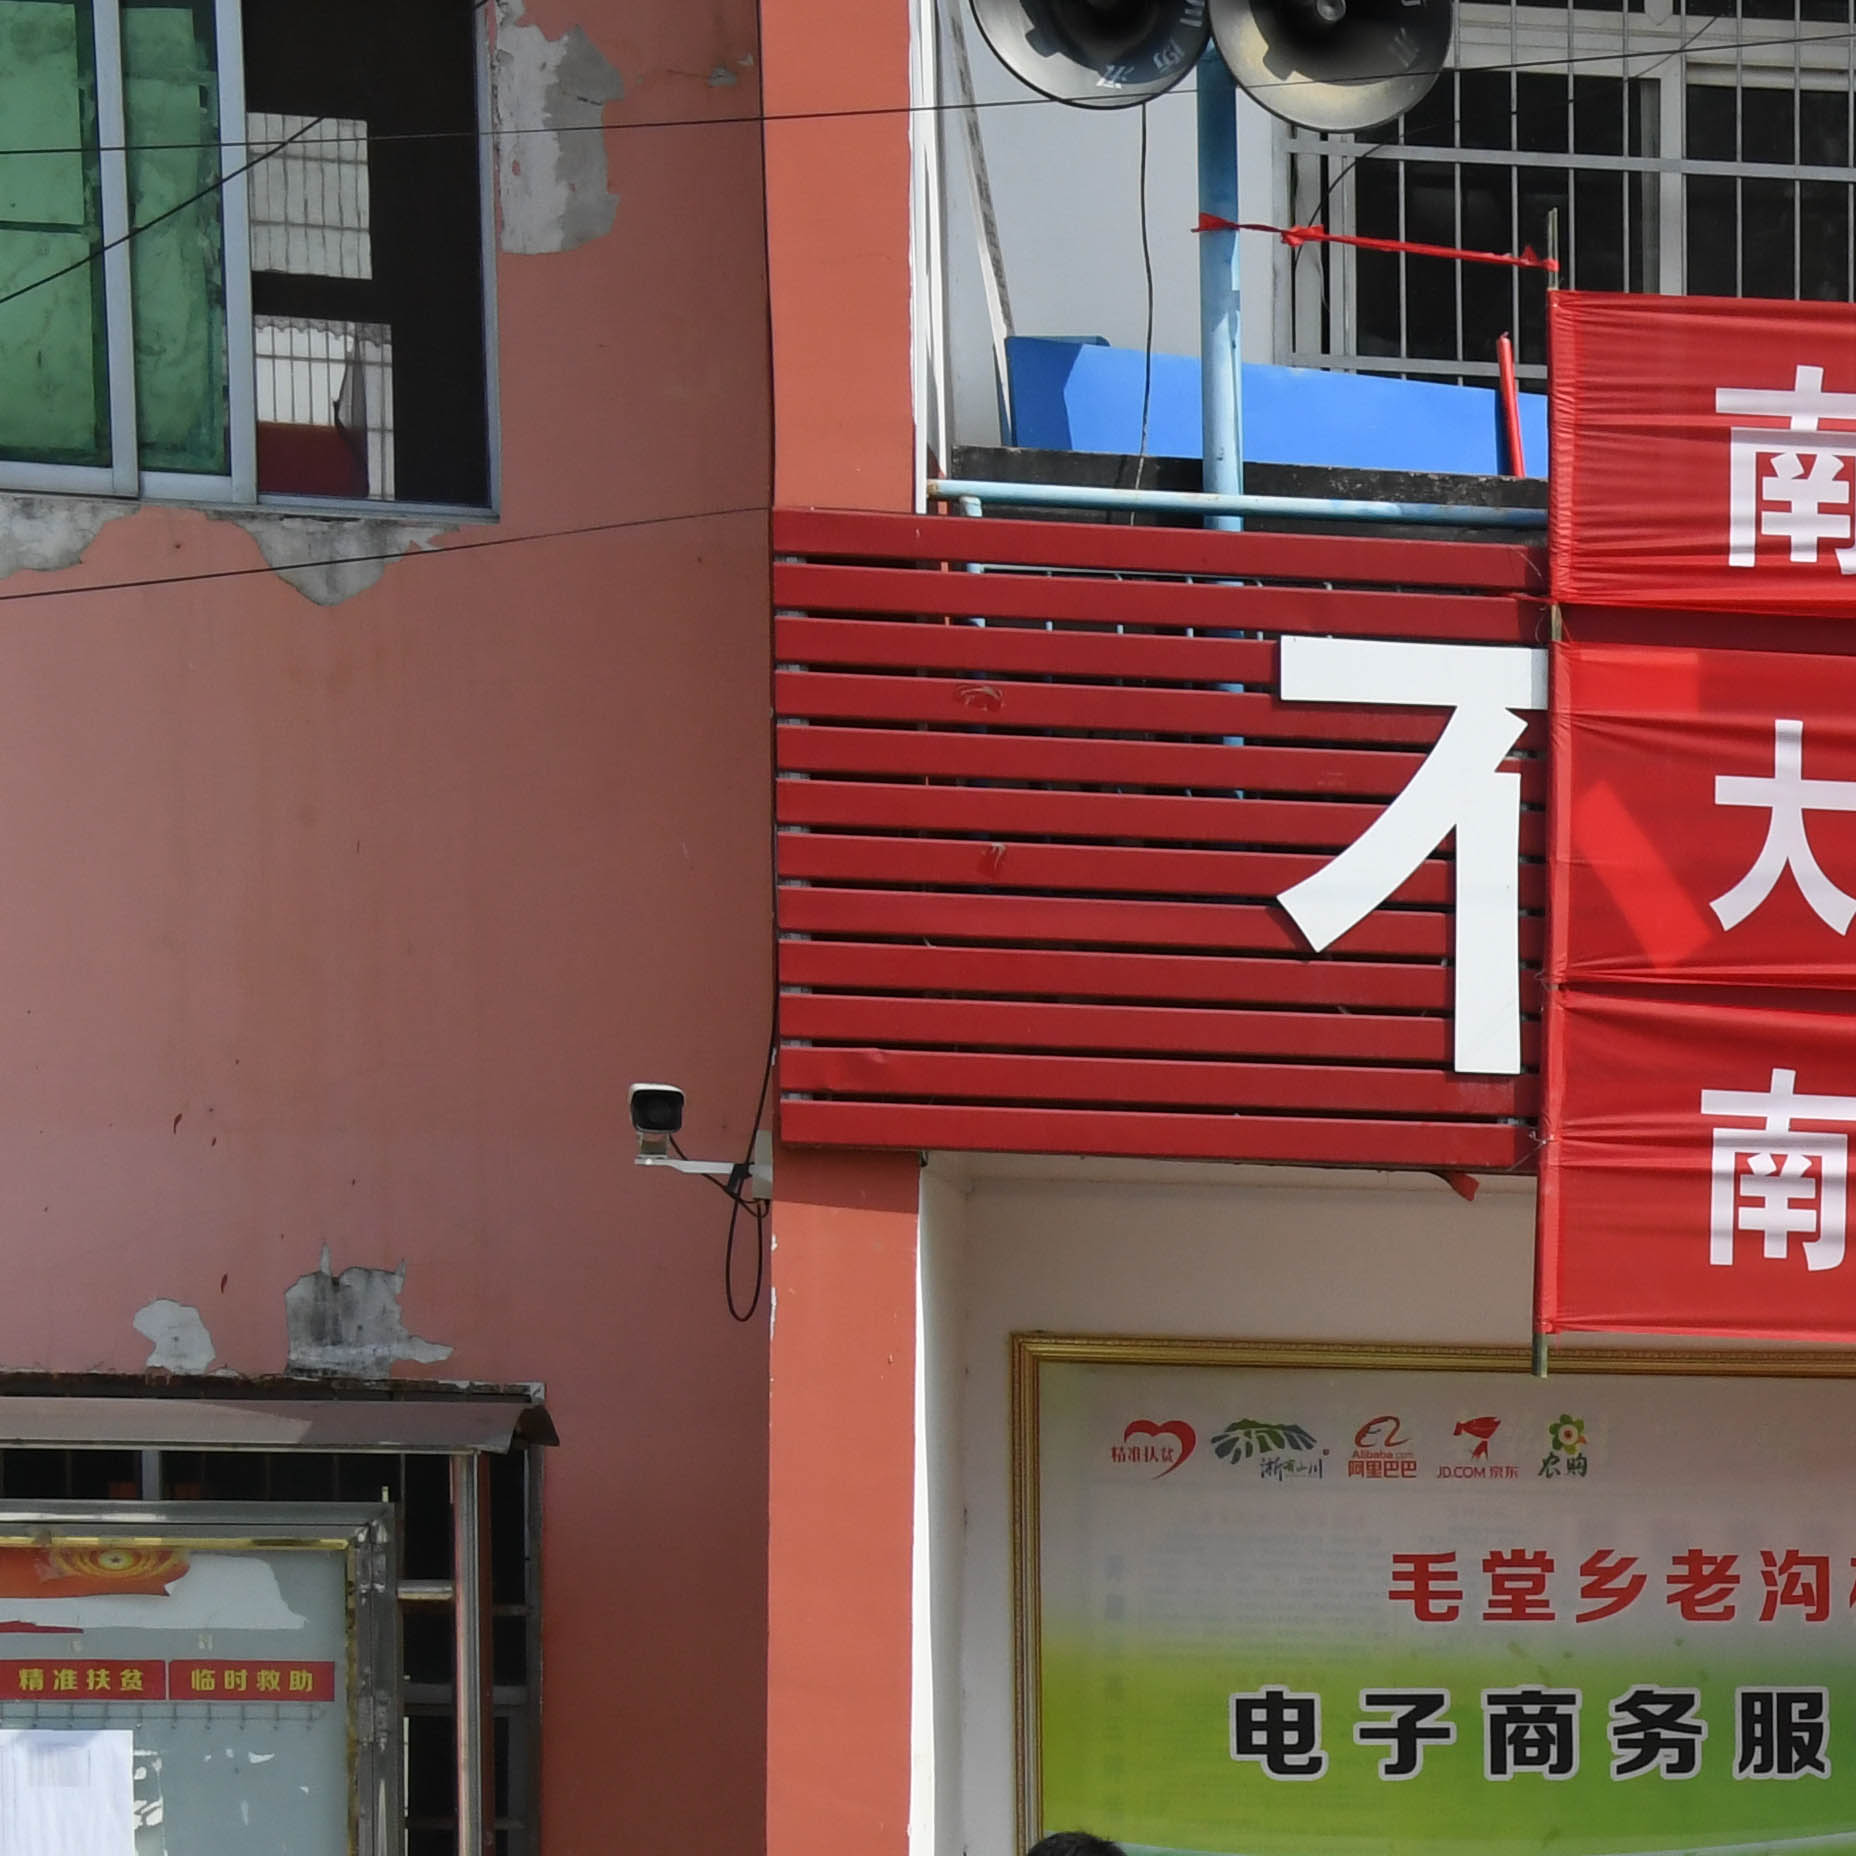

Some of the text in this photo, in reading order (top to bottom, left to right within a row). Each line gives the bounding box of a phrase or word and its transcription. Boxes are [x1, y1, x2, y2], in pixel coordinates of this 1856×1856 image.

[1348, 1460, 1417, 1479] 阿里巴巴
[1437, 1465, 1486, 1479] JD.COM
[18, 1667, 144, 1693] 精准扶贫
[190, 1668, 314, 1693] 临时救助
